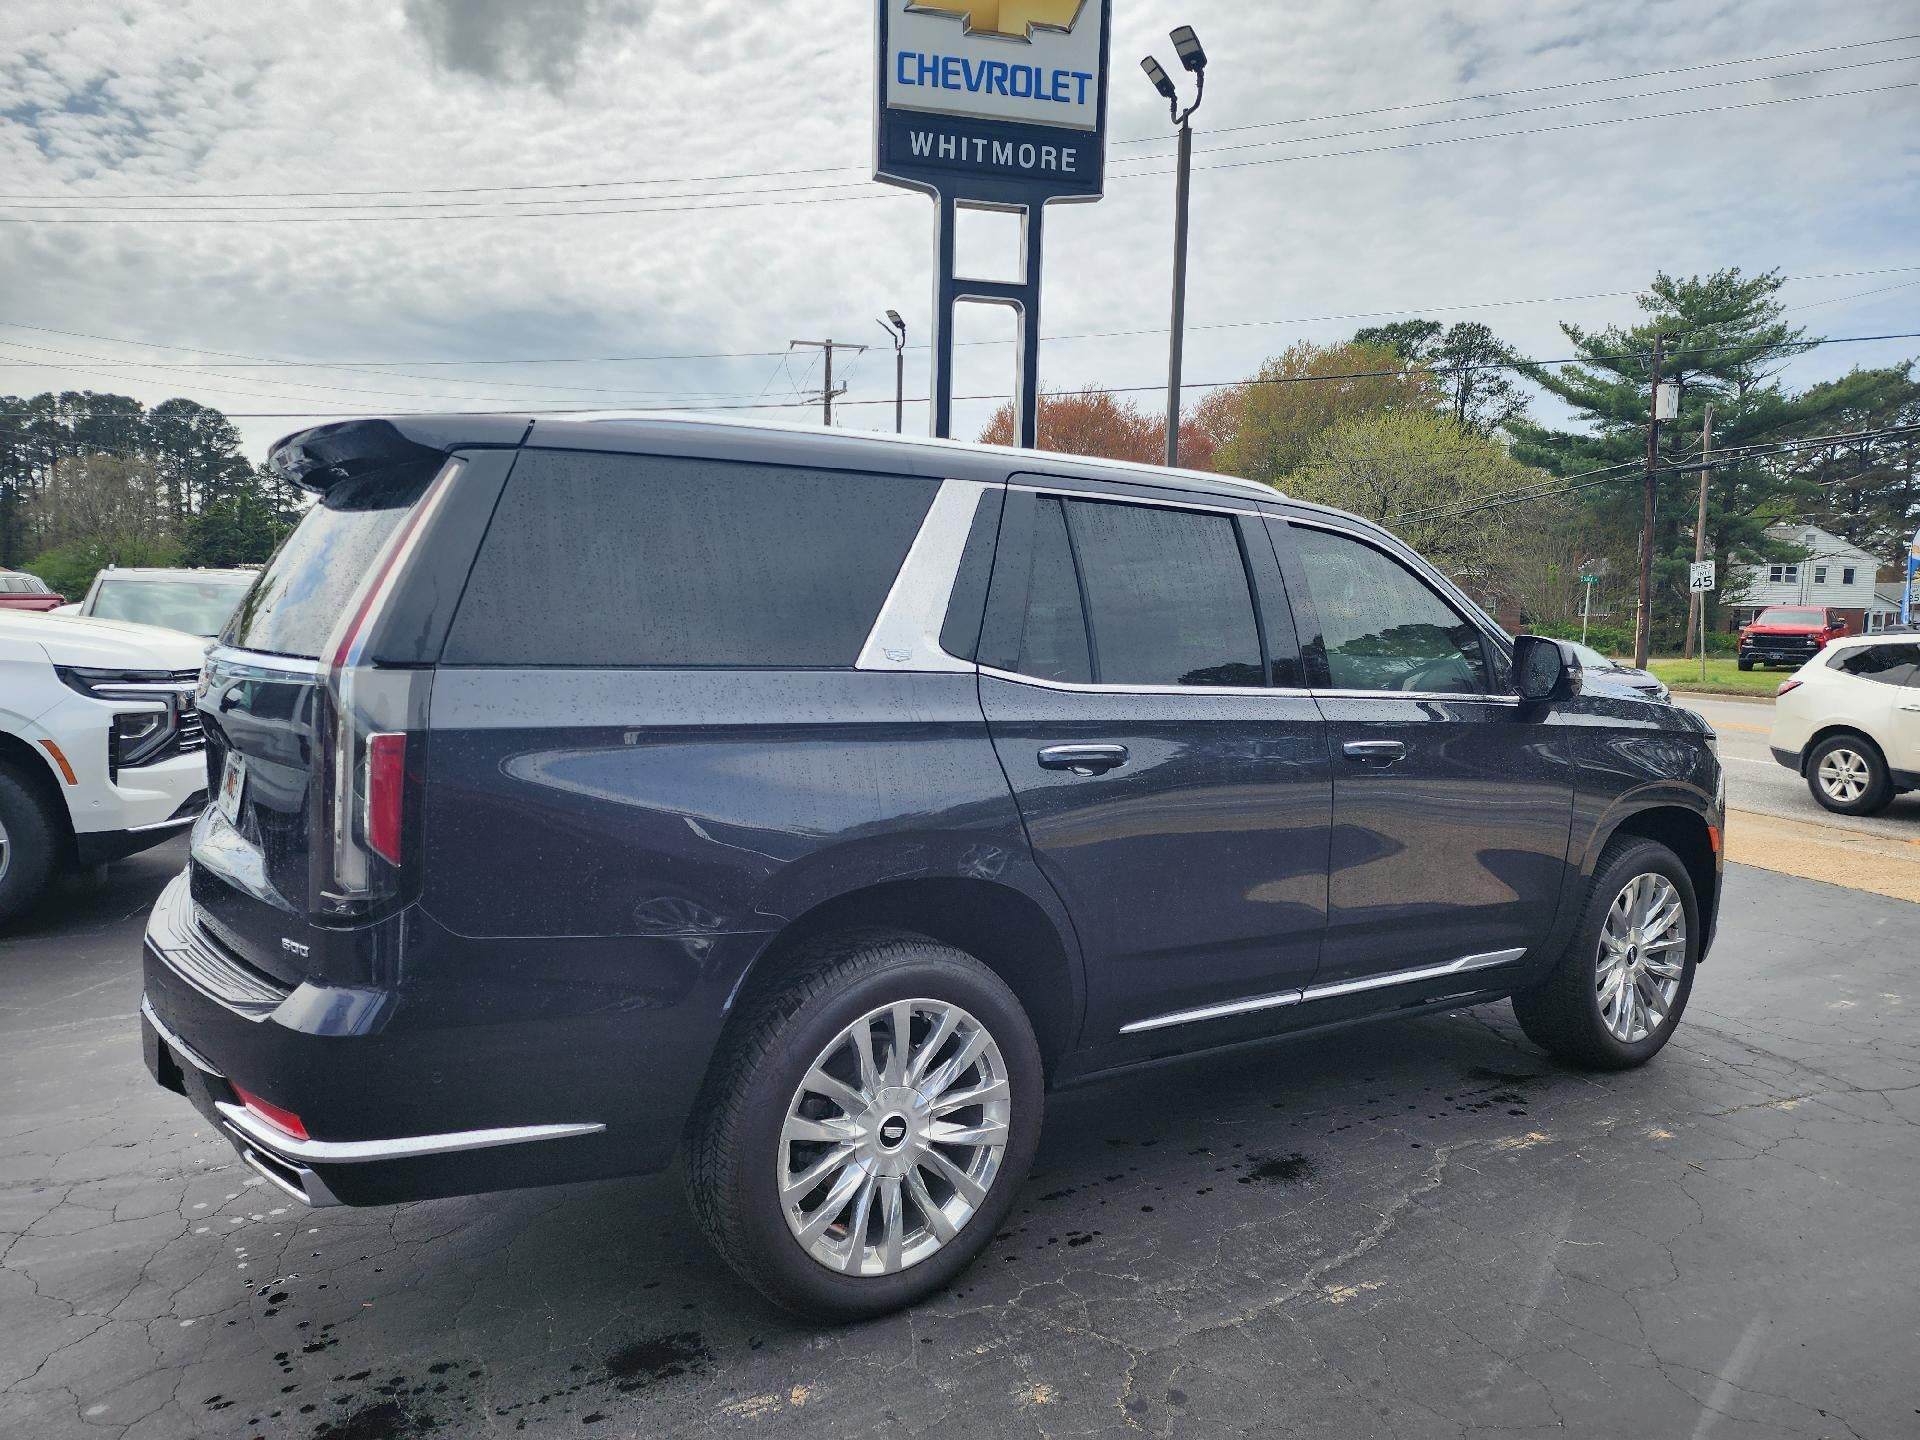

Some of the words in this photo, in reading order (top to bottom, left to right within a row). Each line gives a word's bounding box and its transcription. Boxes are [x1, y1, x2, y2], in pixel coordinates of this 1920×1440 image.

[897, 51, 1093, 105] CHEVROLET
[910, 130, 1077, 172] WHITMORE
[1692, 576, 1713, 588] 45
[281, 937, 310, 958] 600
